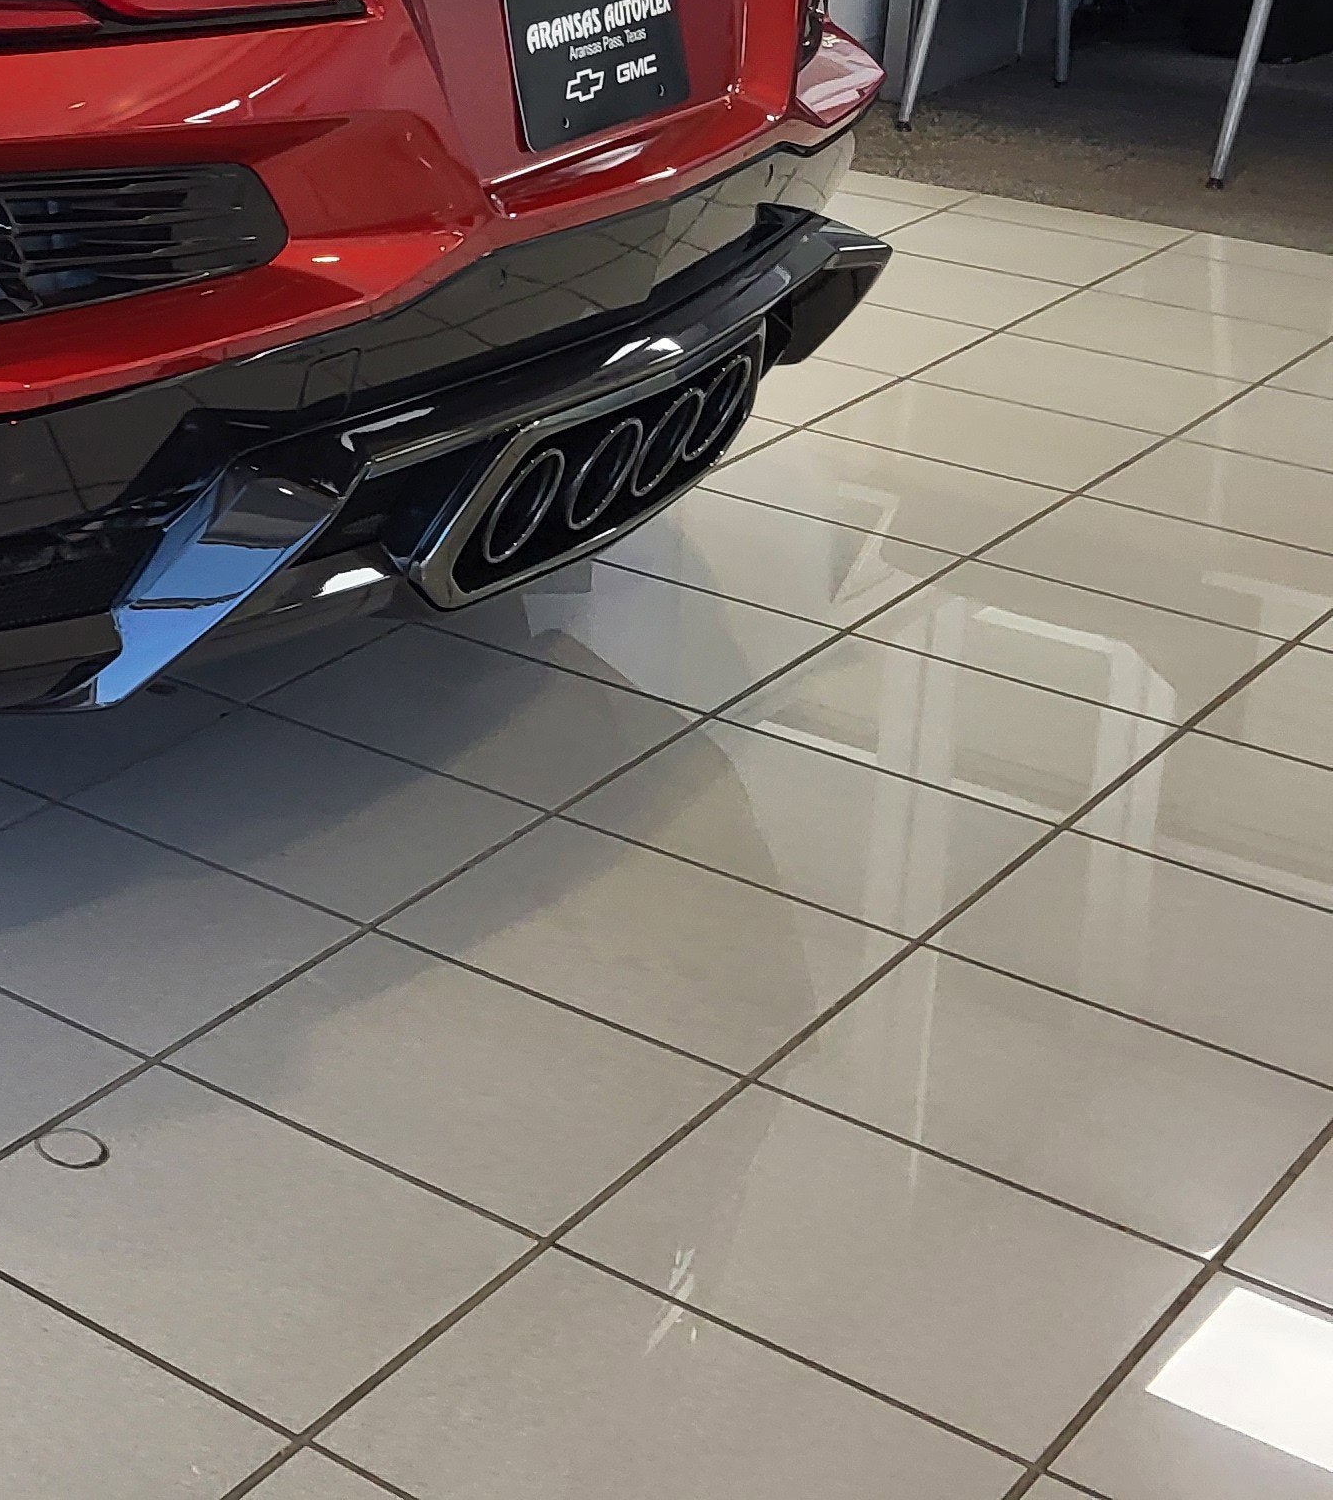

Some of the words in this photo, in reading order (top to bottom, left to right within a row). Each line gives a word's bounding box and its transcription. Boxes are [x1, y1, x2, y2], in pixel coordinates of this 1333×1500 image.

[526, 7, 602, 55] ARANSAS
[569, 41, 603, 62] Aransas
[602, 34, 625, 51] Pass,
[623, 27, 647, 44] Texas
[616, 53, 658, 84] GMC
